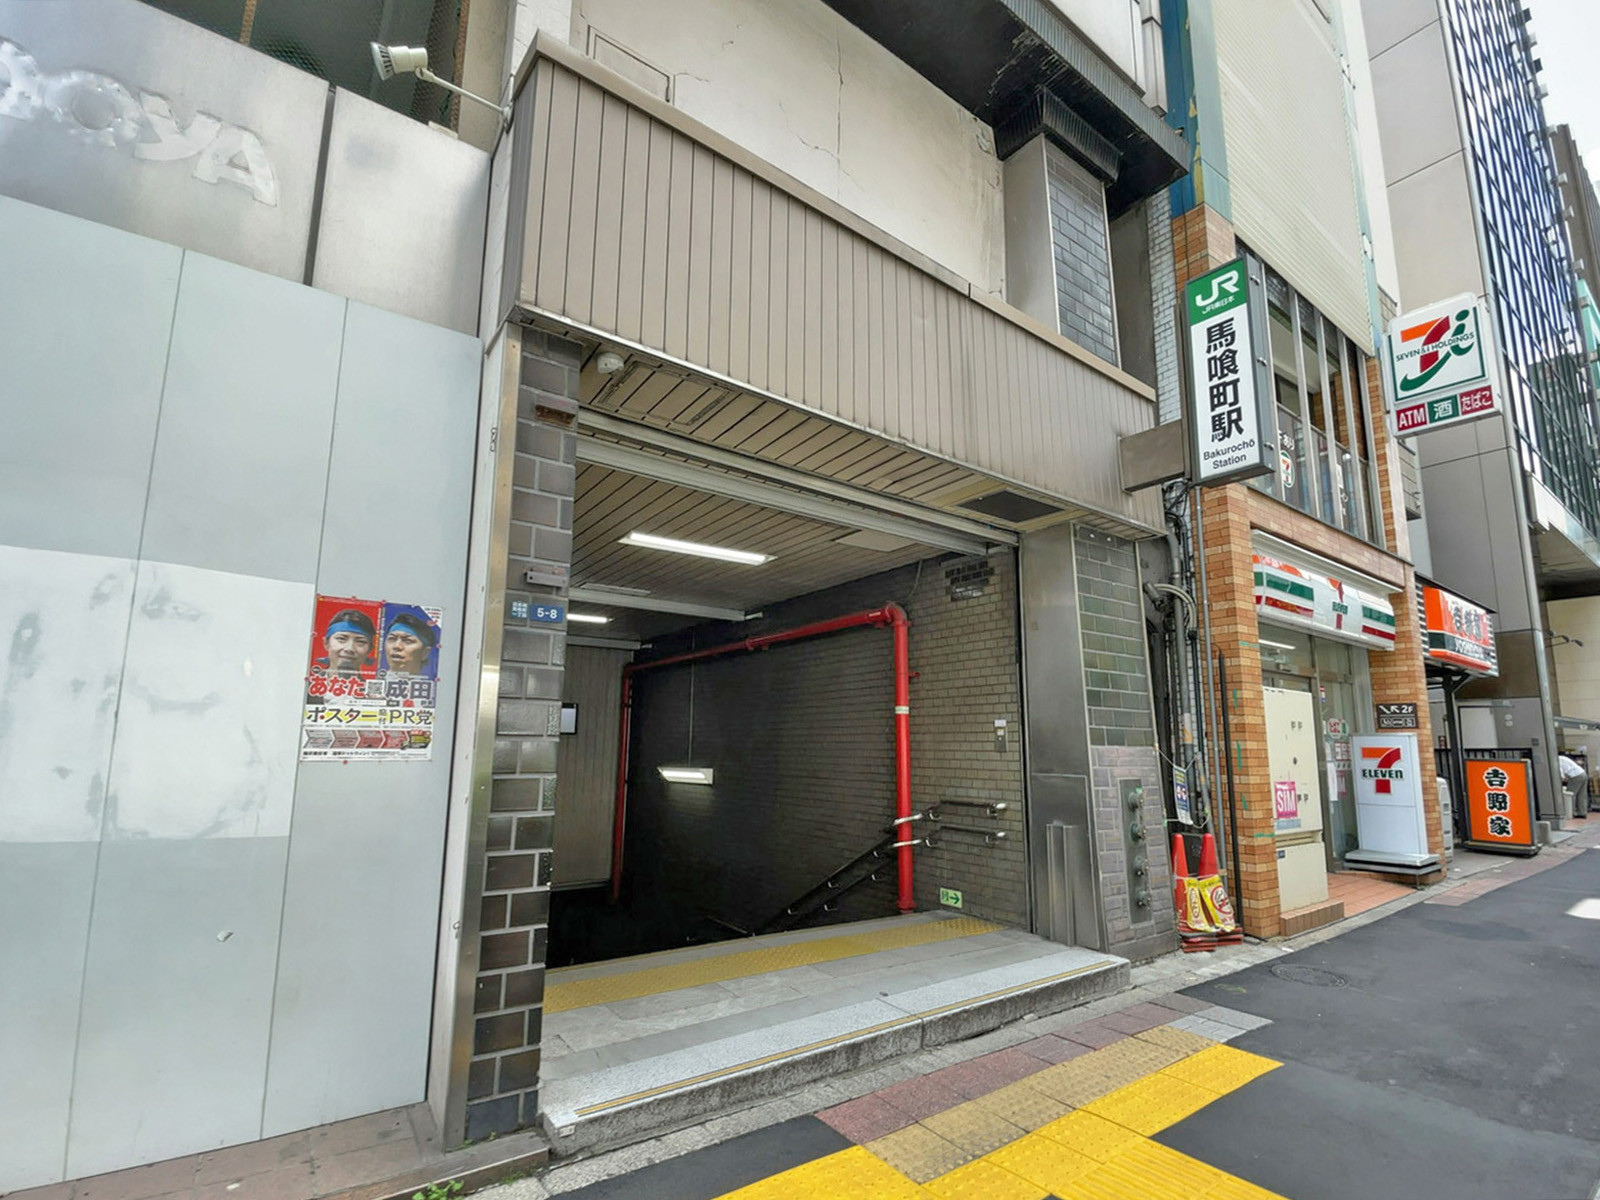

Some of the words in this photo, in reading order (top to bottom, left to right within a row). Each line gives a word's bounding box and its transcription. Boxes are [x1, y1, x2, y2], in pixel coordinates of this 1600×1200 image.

[1195, 269, 1239, 307] JR
[1202, 296, 1235, 314] JR東日本
[1431, 332, 1474, 351] HOLDINGS
[1205, 317, 1244, 443] 馬喰町駅
[1433, 400, 1452, 420] 酒
[1461, 391, 1492, 412] たばこ
[1398, 408, 1425, 428] ATM
[1203, 438, 1255, 461] Bakurochō
[1212, 453, 1247, 470] Station
[537, 607, 558, 619] 5-8
[309, 675, 366, 698] あなた
[386, 680, 434, 700] 成田
[306, 707, 377, 724] ポスター
[389, 709, 433, 725] PR党
[1401, 705, 1413, 714] 2F
